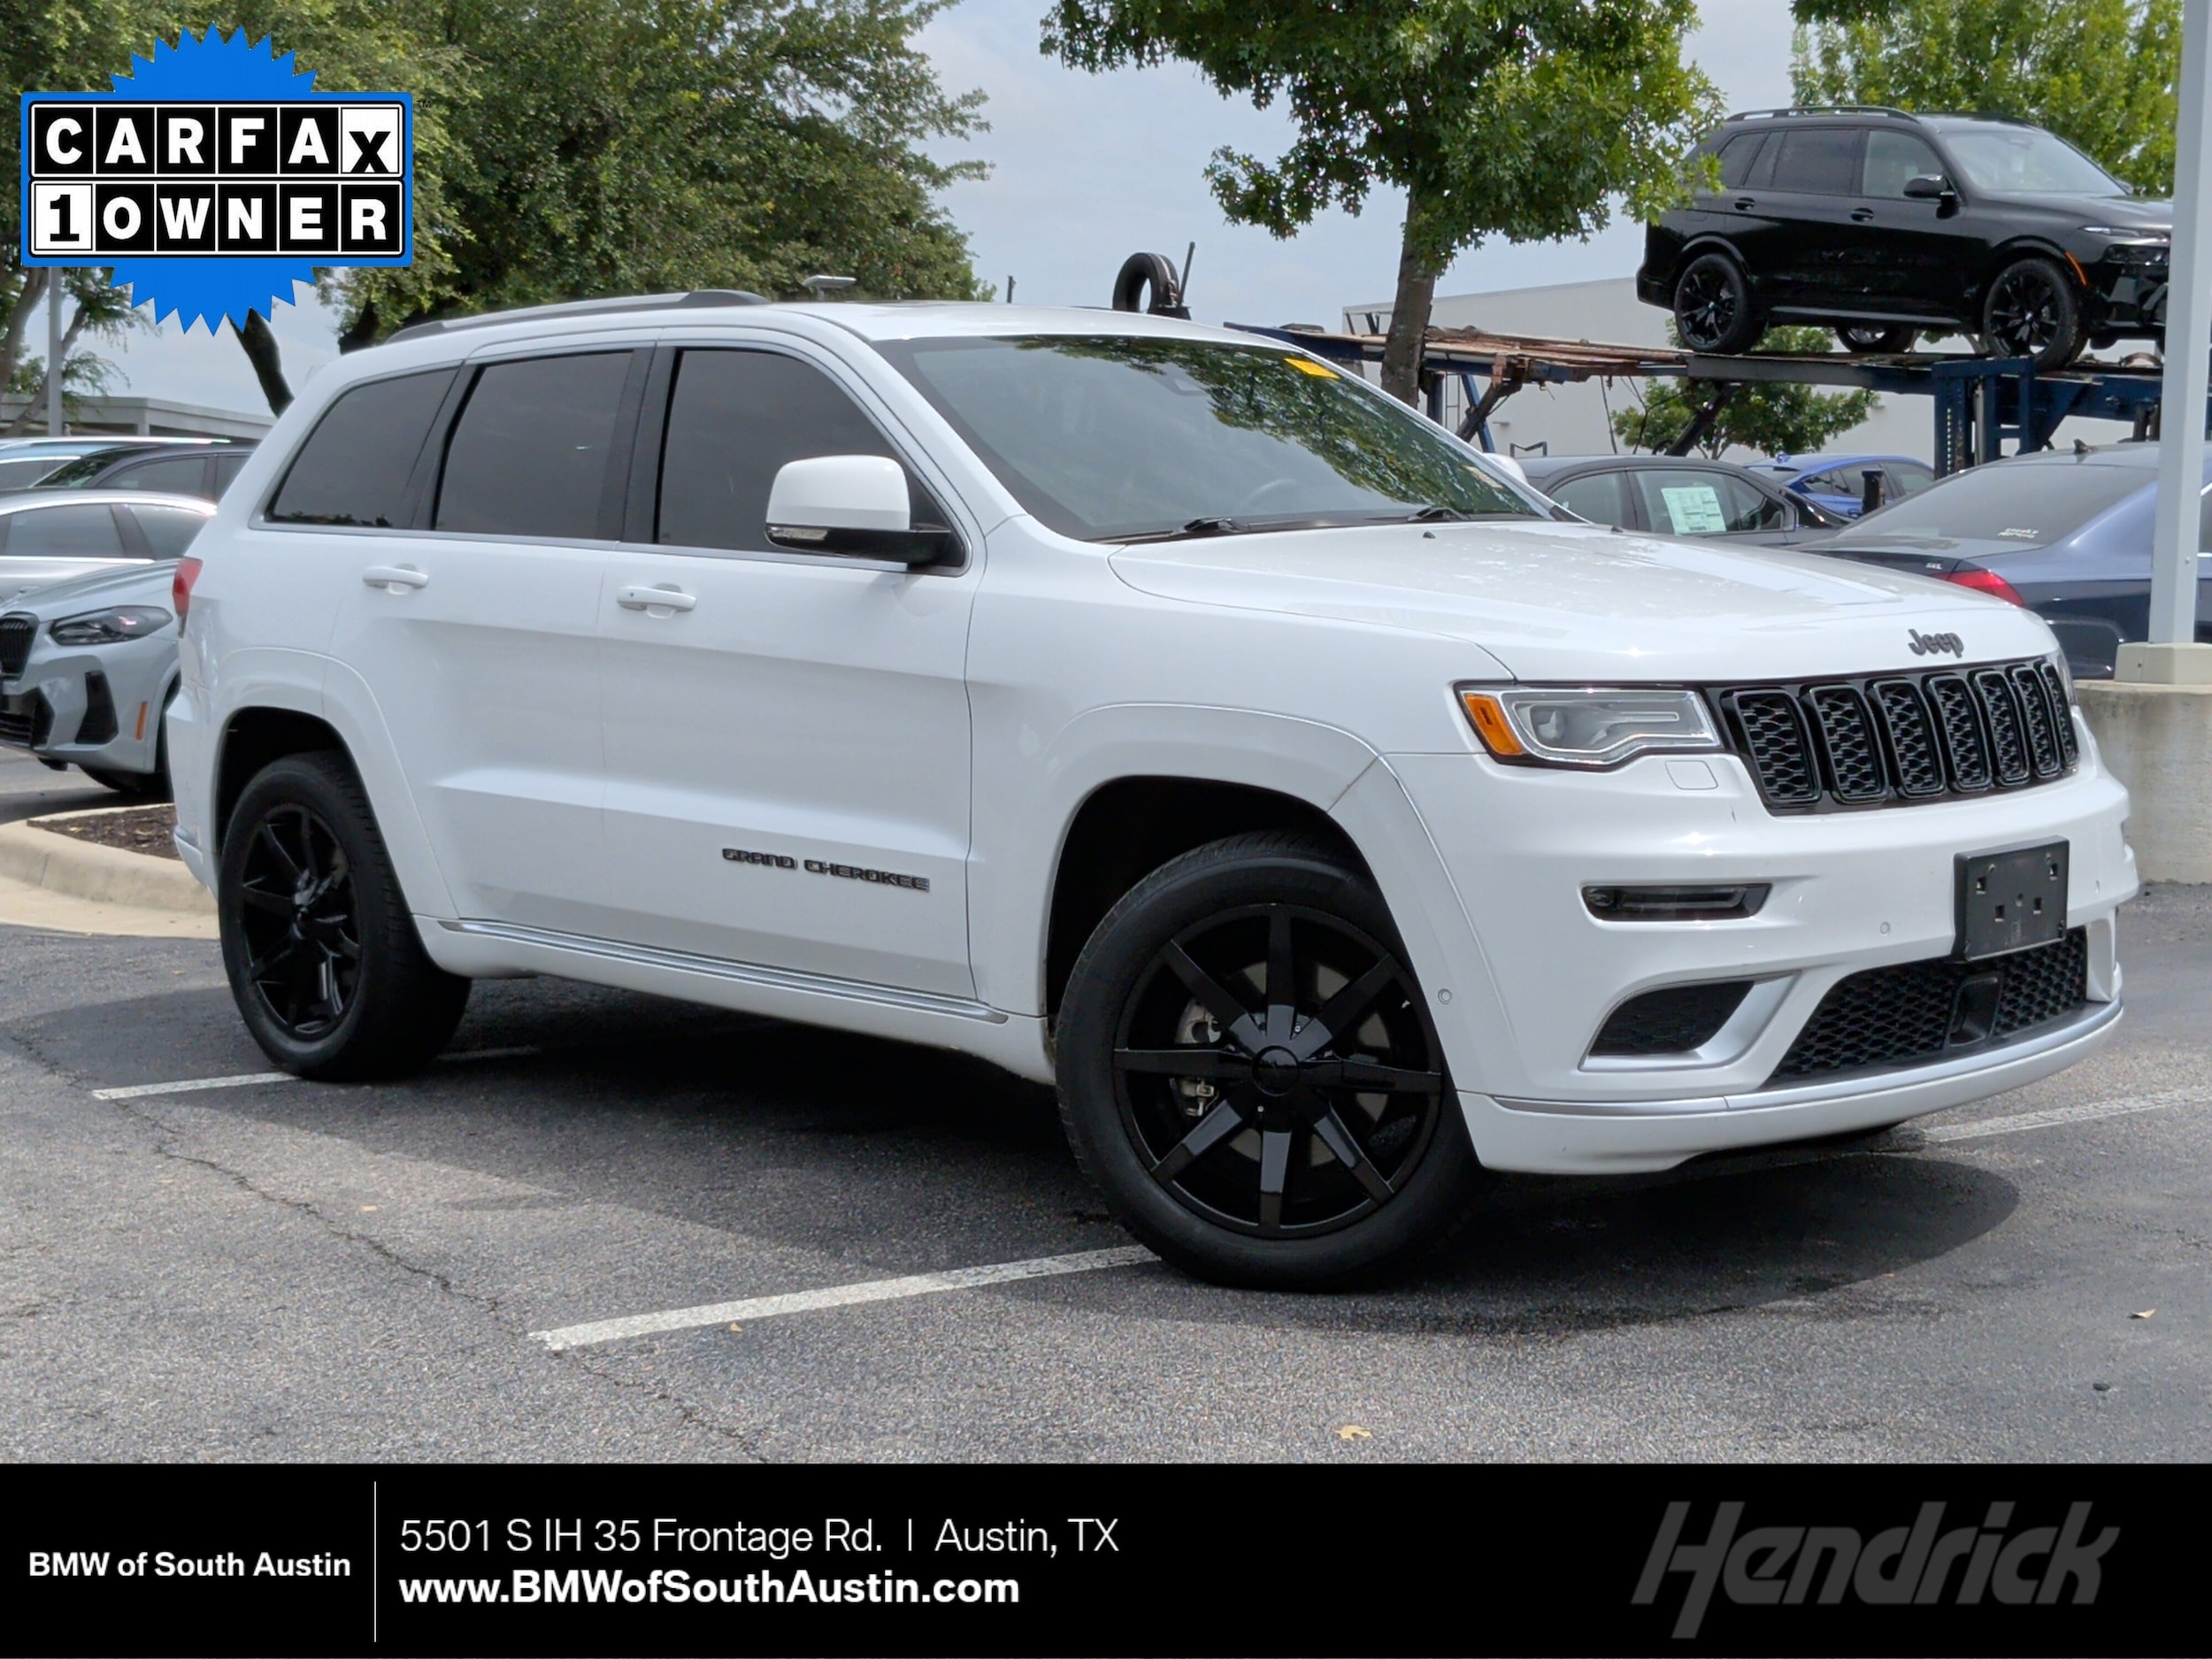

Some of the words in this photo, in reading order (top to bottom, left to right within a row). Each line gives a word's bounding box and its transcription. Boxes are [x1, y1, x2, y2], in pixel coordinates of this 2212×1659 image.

[1908, 628, 1964, 658] Jeep
[722, 848, 797, 869] GRAND
[803, 859, 930, 892] CHEROKEE
